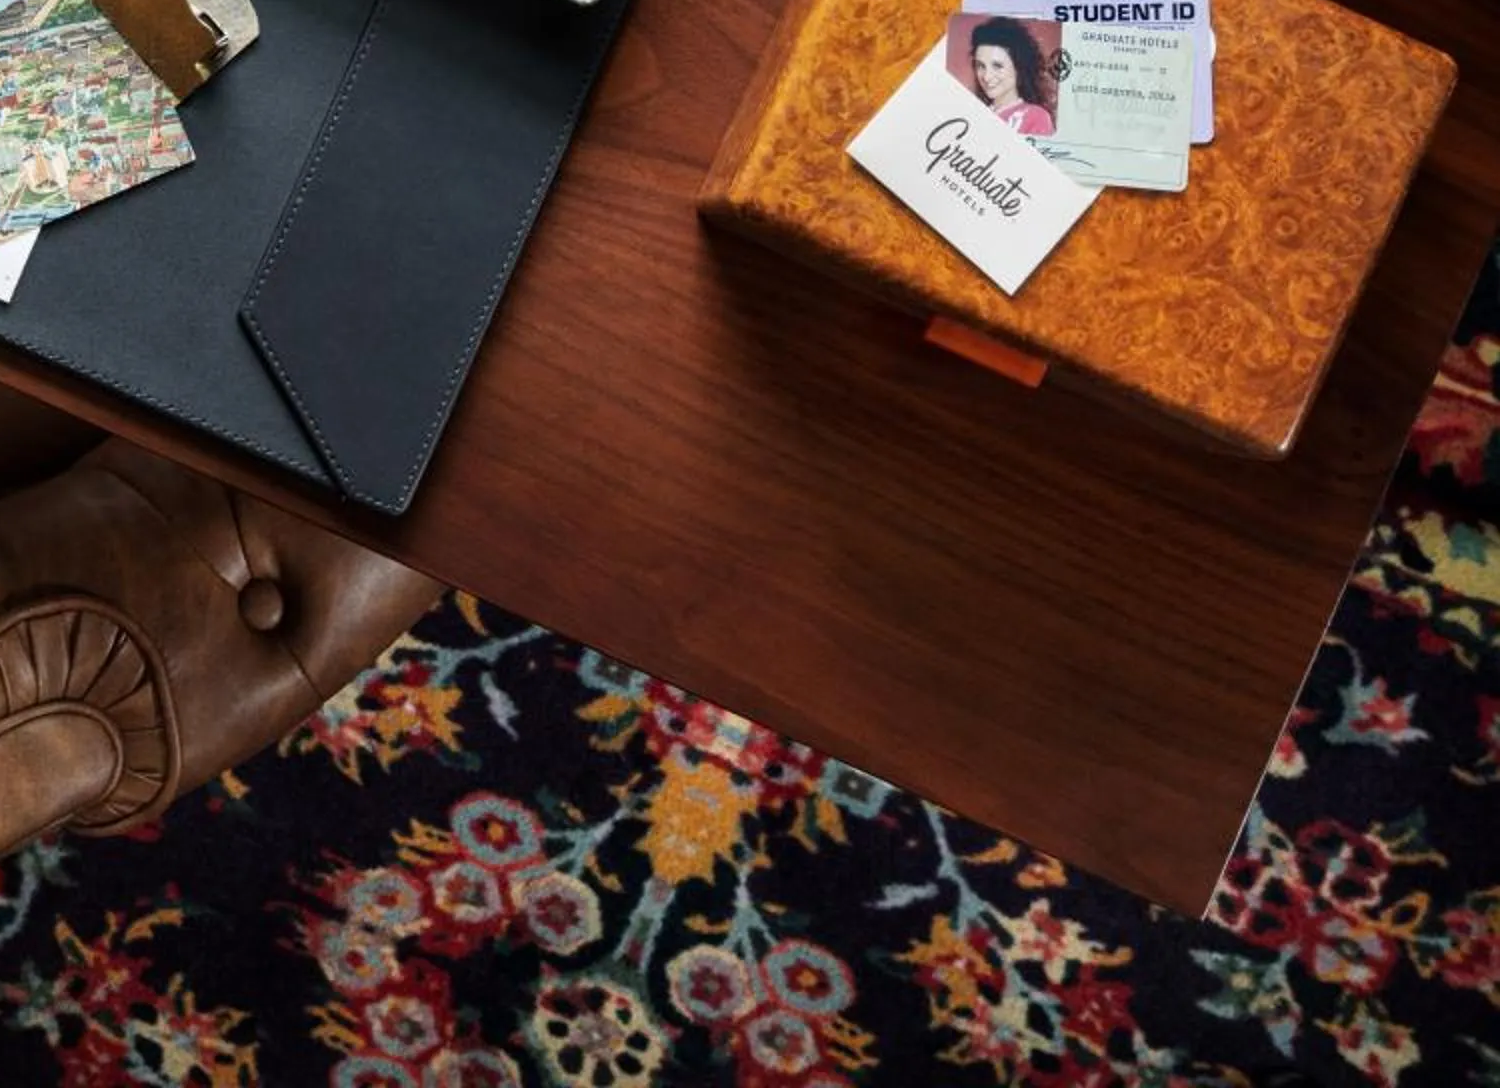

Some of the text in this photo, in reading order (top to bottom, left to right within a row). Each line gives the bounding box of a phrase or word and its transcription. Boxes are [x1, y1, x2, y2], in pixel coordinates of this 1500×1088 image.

[1054, 2, 1195, 23] STUDENT ID
[1082, 31, 1179, 50] GRADUATE HOTELS
[925, 118, 1031, 217] Graduate
[940, 175, 986, 217] HOTELS
